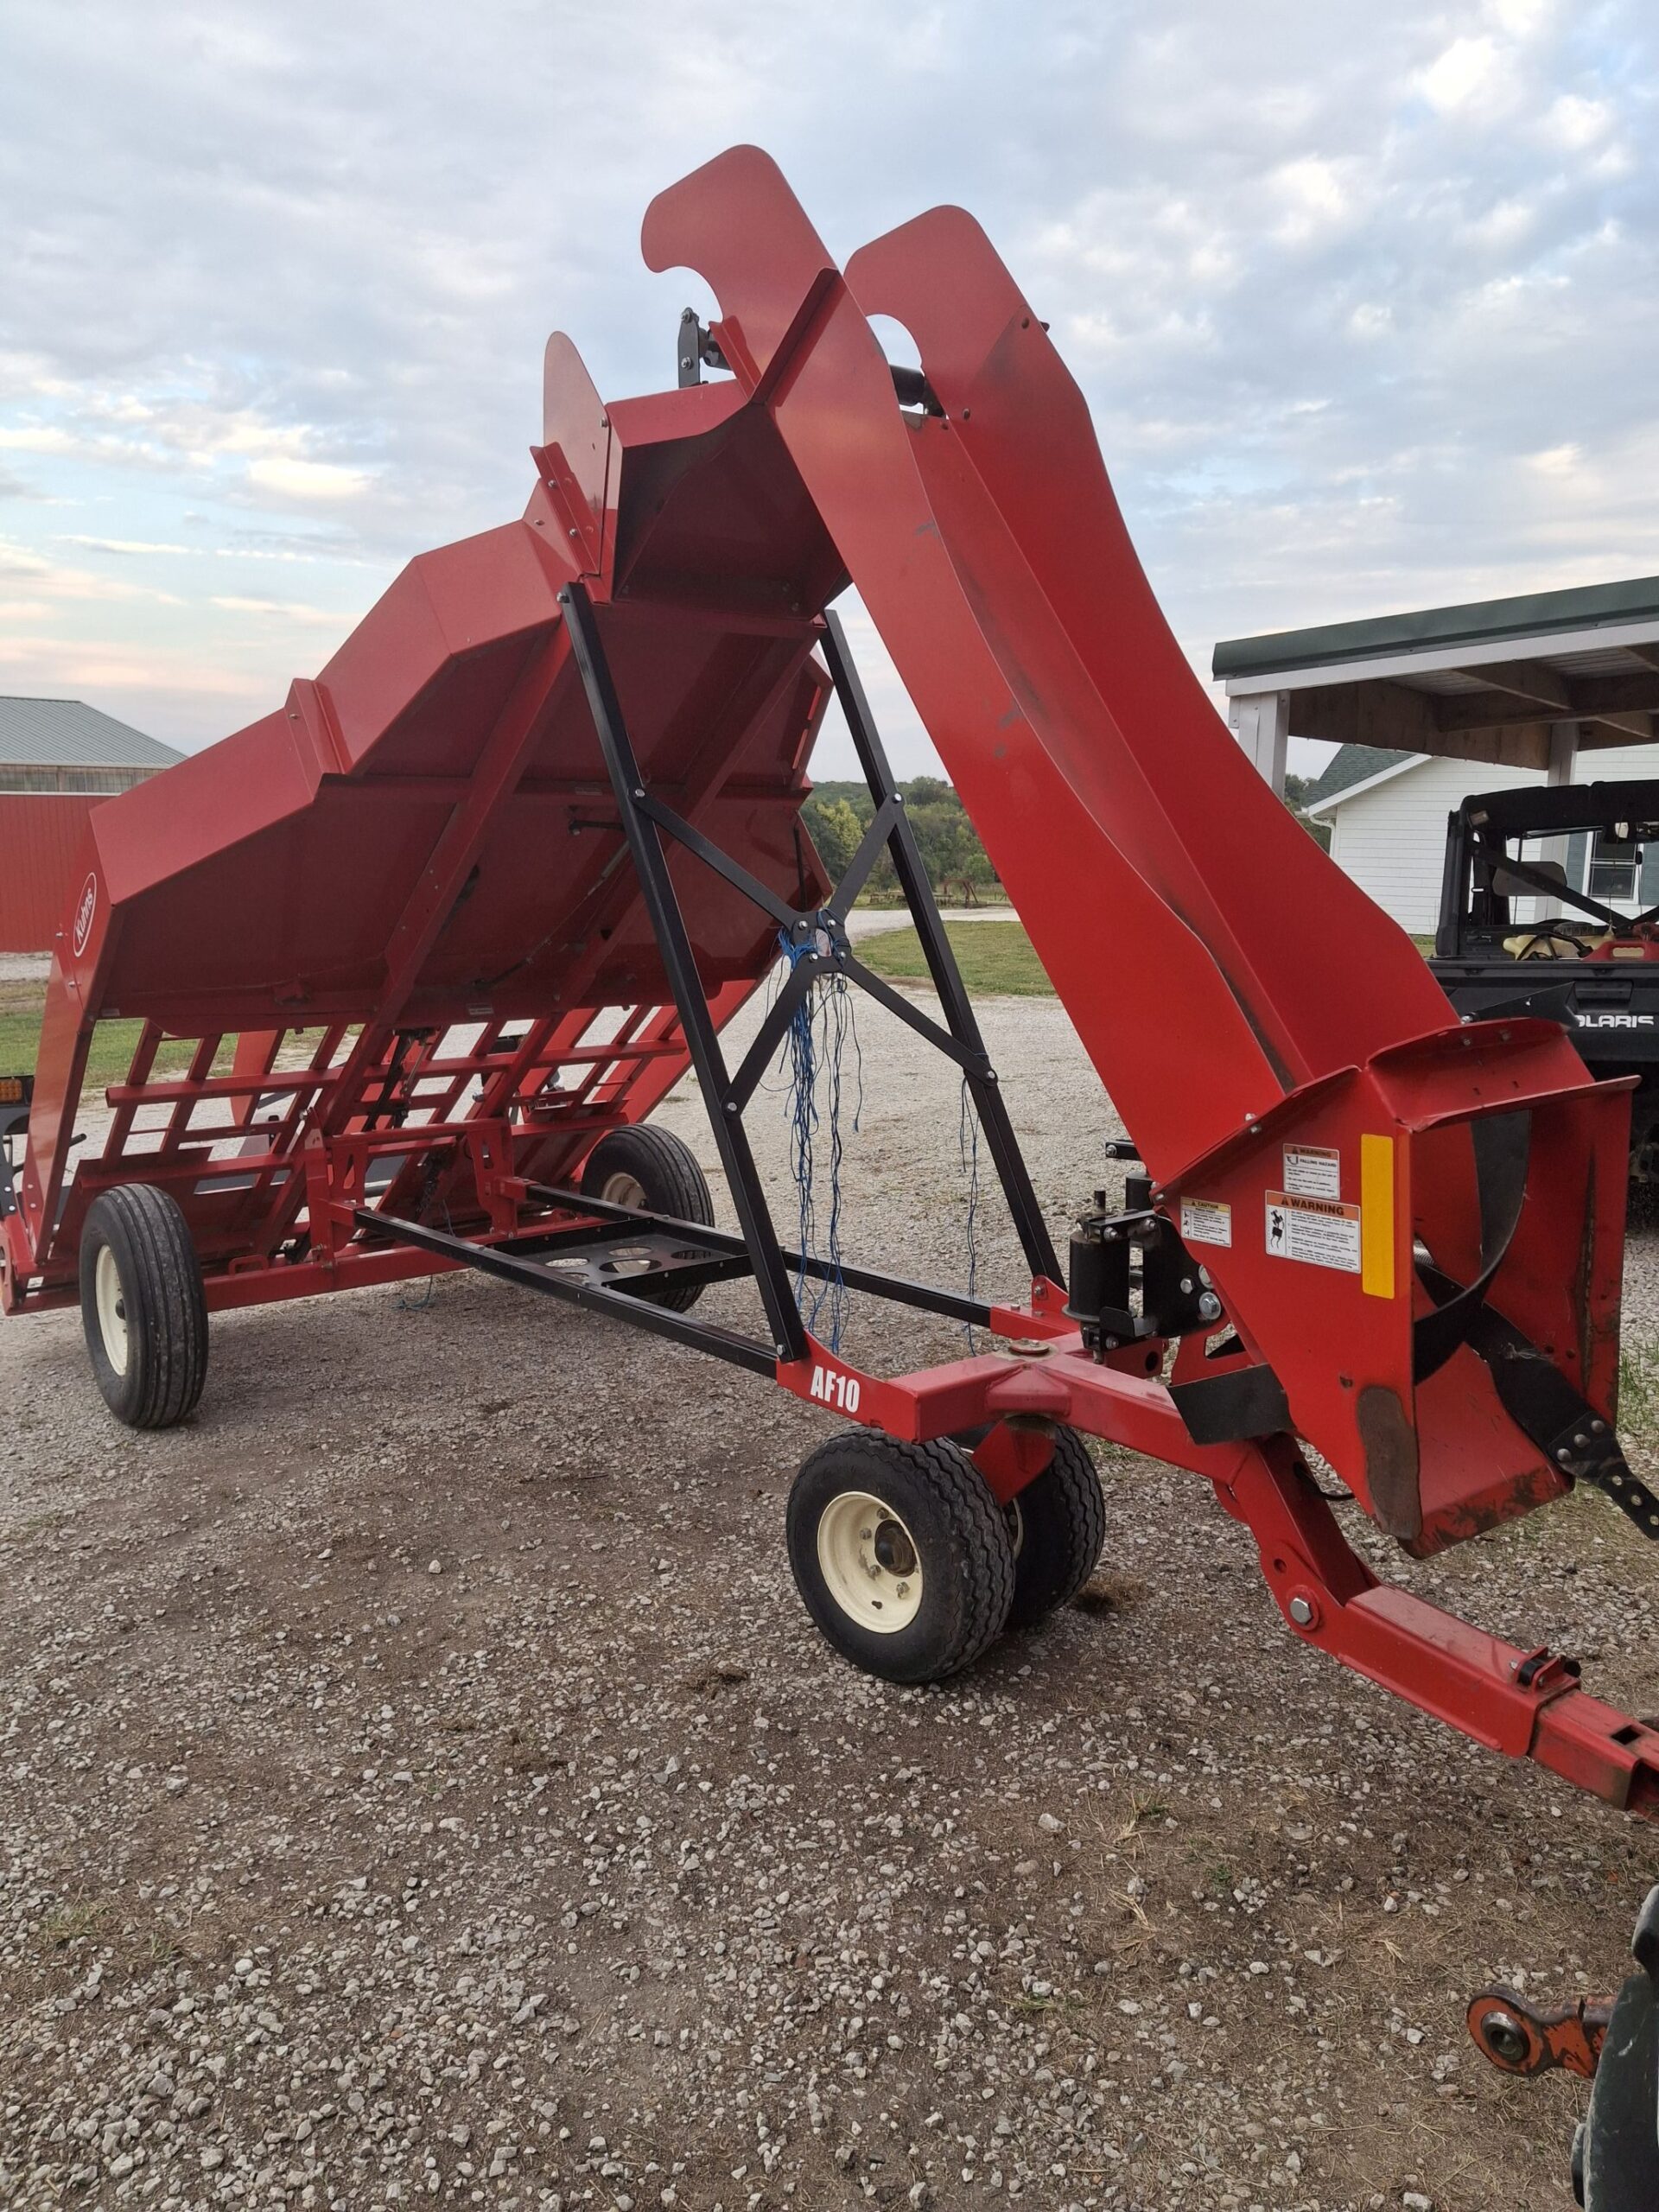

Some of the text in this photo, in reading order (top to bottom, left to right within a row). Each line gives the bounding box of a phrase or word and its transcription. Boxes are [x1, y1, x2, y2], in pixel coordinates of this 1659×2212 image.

[75, 887, 93, 944] Kuhns
[1300, 1148, 1332, 1158] WARNING
[1291, 1198, 1344, 1217] WARNING
[810, 1365, 861, 1414] AF10
